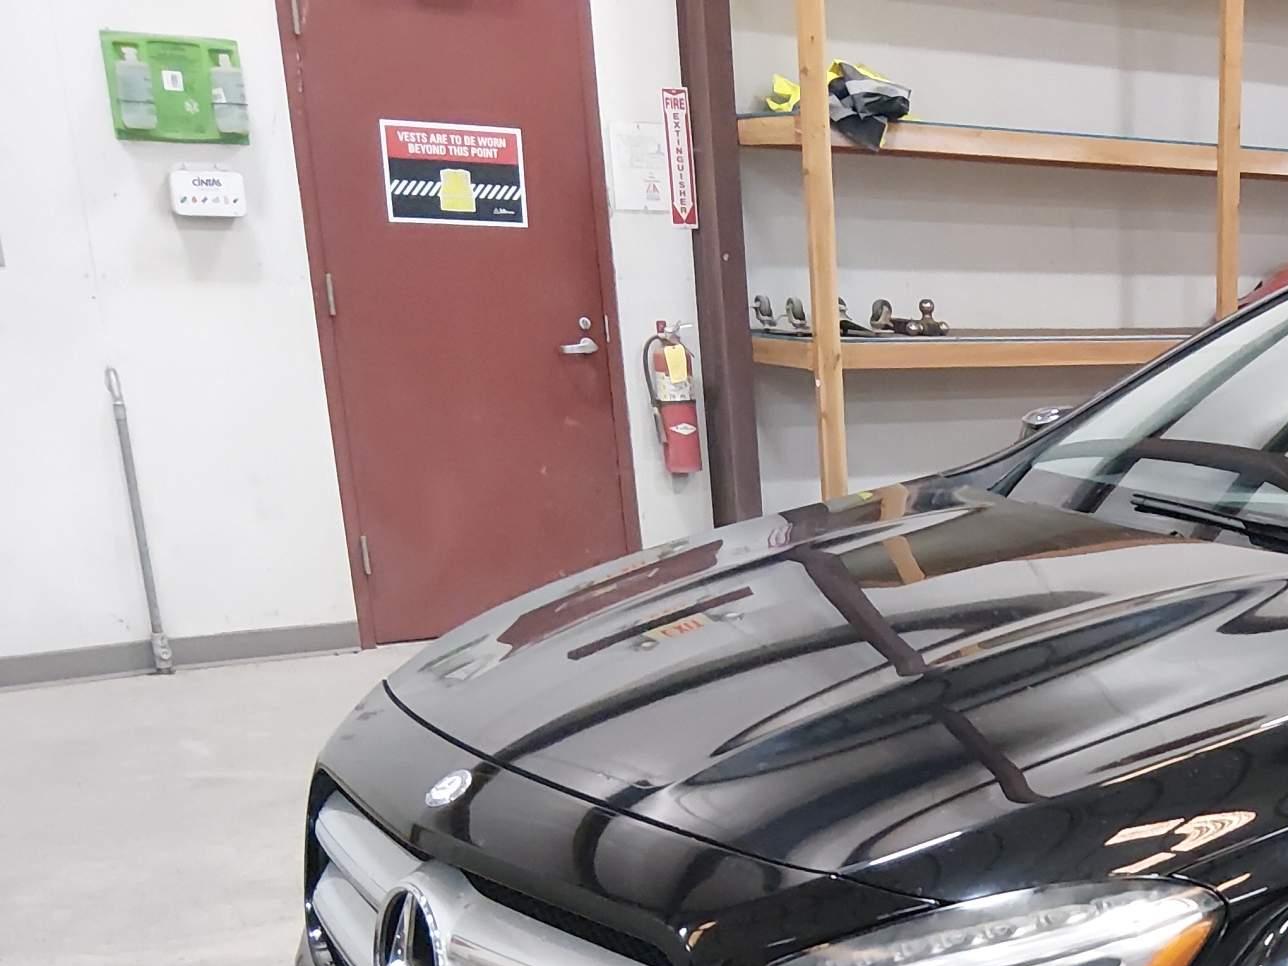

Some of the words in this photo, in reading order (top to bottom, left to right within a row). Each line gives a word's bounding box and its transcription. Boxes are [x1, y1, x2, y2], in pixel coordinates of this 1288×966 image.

[665, 97, 685, 110] FIRE
[397, 130, 428, 143] VESTS
[429, 133, 448, 144] ARE
[449, 134, 461, 145] TO
[464, 135, 476, 146] BE
[477, 136, 506, 148] WORN
[408, 143, 446, 156] BEYOND
[447, 145, 469, 157] THIS
[471, 147, 498, 159] POINT
[672, 112, 687, 214] EXTINGUISHER
